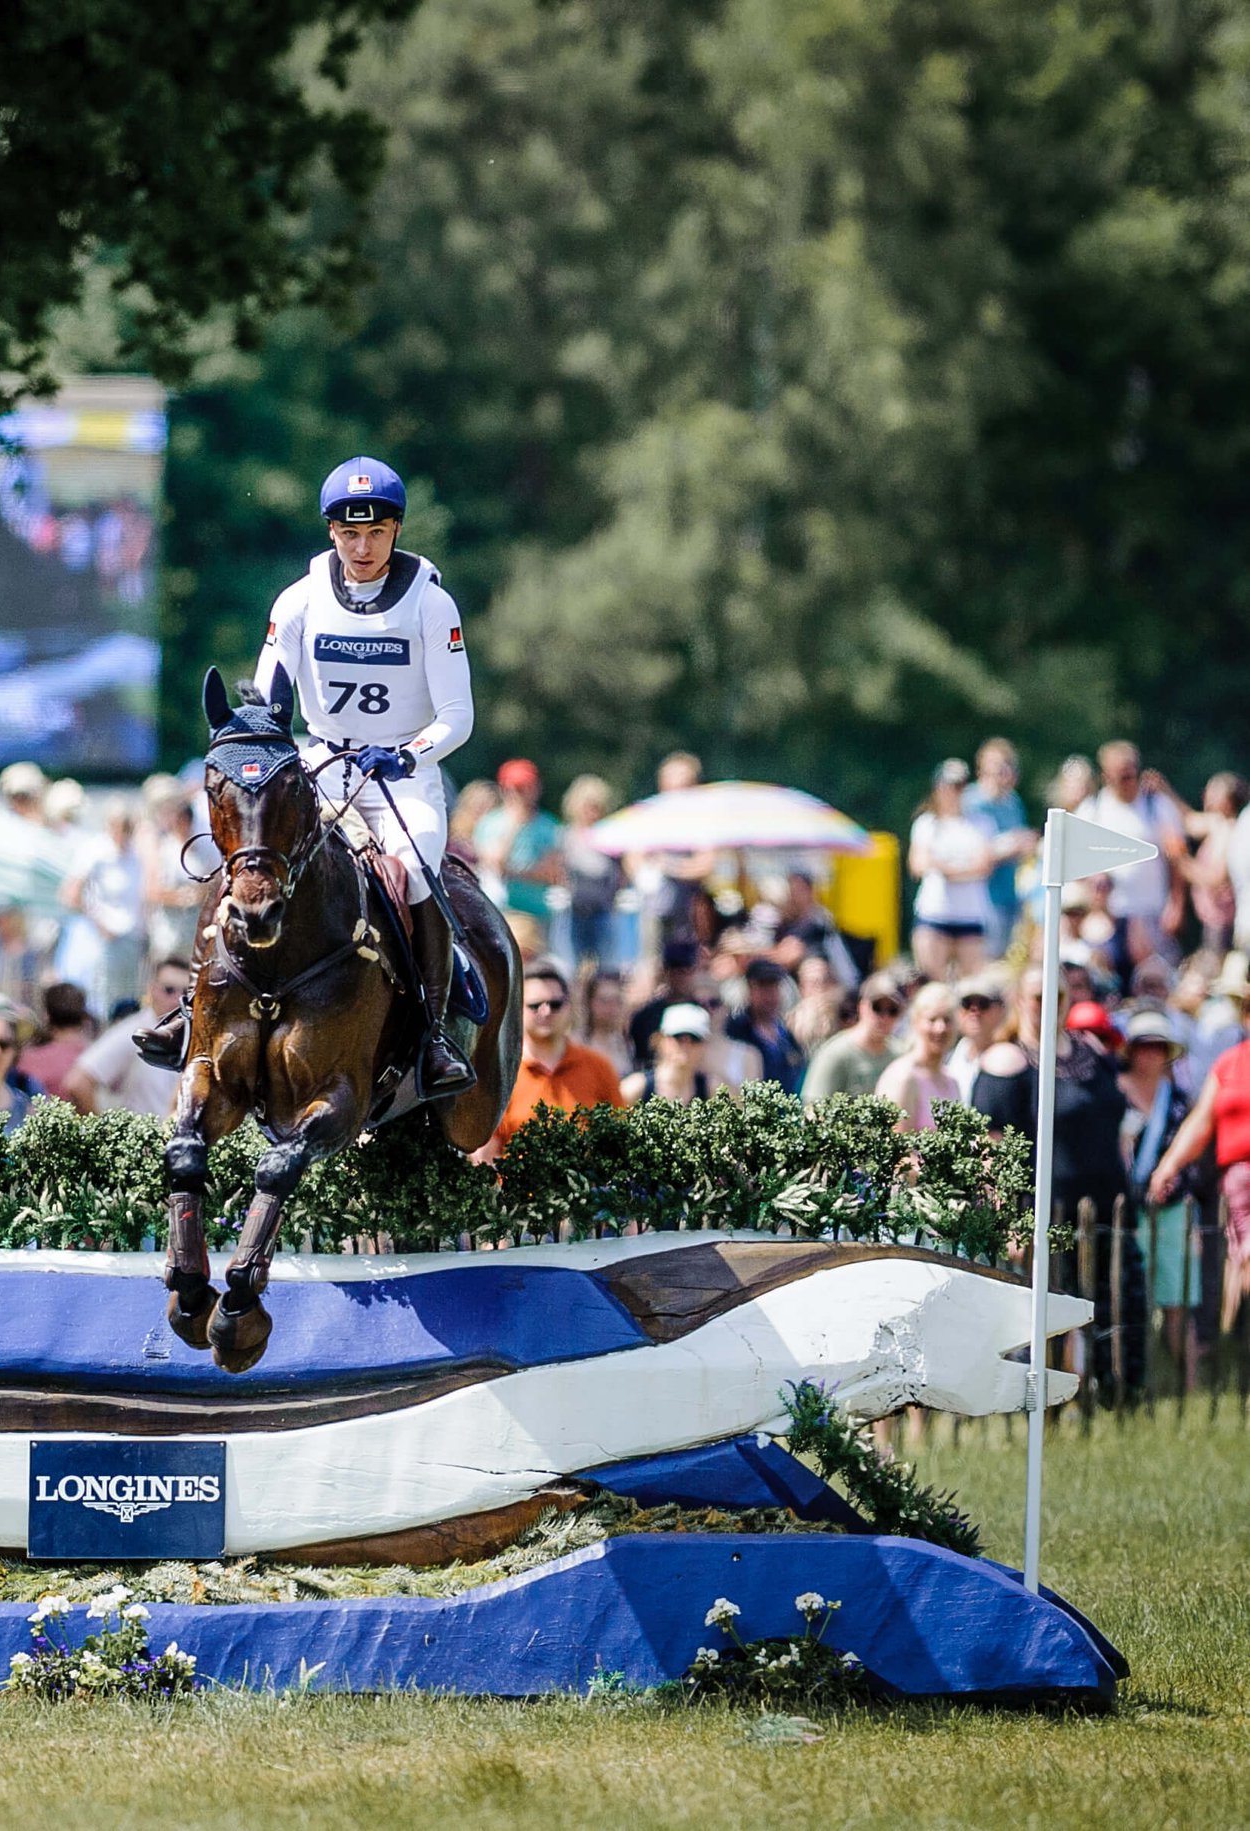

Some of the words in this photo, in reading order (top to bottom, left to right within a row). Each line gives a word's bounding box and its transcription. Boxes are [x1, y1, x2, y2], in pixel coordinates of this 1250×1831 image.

[319, 639, 404, 654] LONGINES
[328, 681, 390, 714] 78
[36, 1475, 220, 1502] LONGINES
